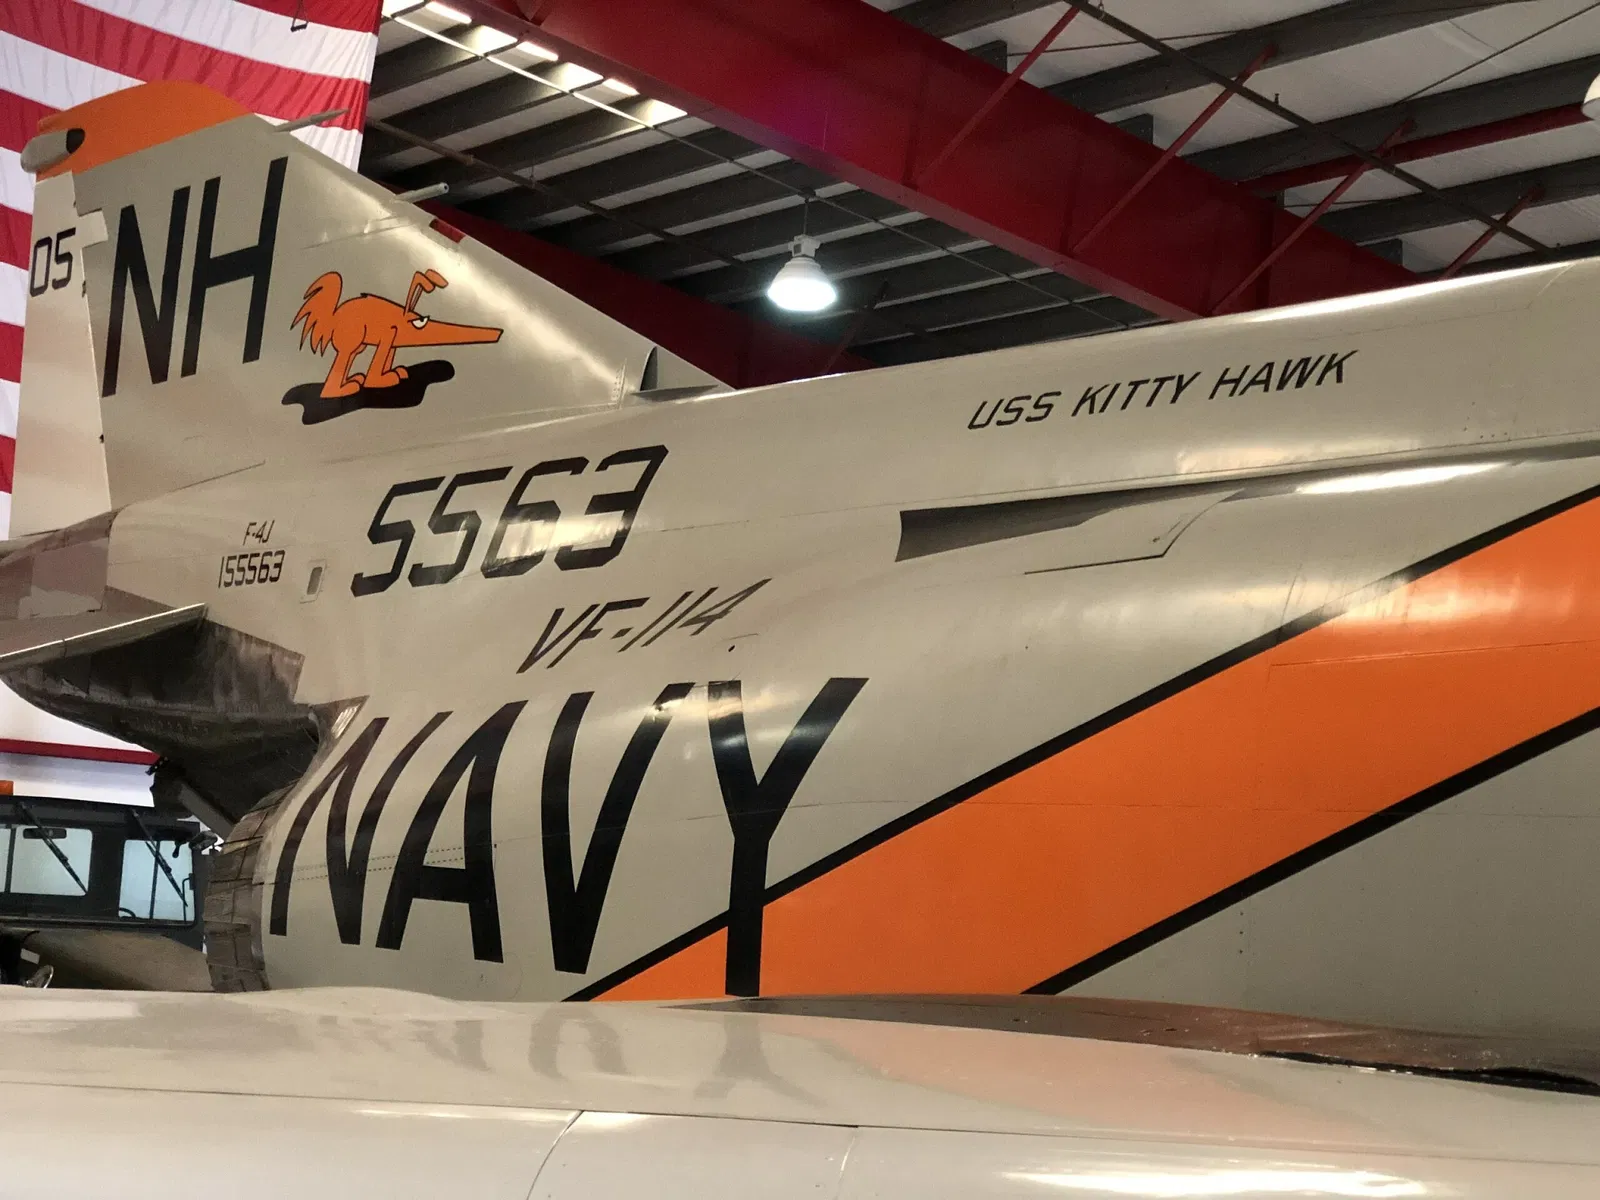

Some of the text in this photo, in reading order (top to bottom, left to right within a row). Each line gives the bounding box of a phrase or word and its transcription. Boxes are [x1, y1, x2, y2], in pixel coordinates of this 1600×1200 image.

[30, 227, 76, 297] 05
[102, 156, 288, 398] NH
[967, 350, 1359, 430] USS KITTY HAWK
[243, 519, 275, 546] F-4J
[350, 444, 669, 597] 5563
[218, 549, 286, 589] 155563
[516, 577, 773, 674] VF-114
[269, 677, 869, 998] NAVY
